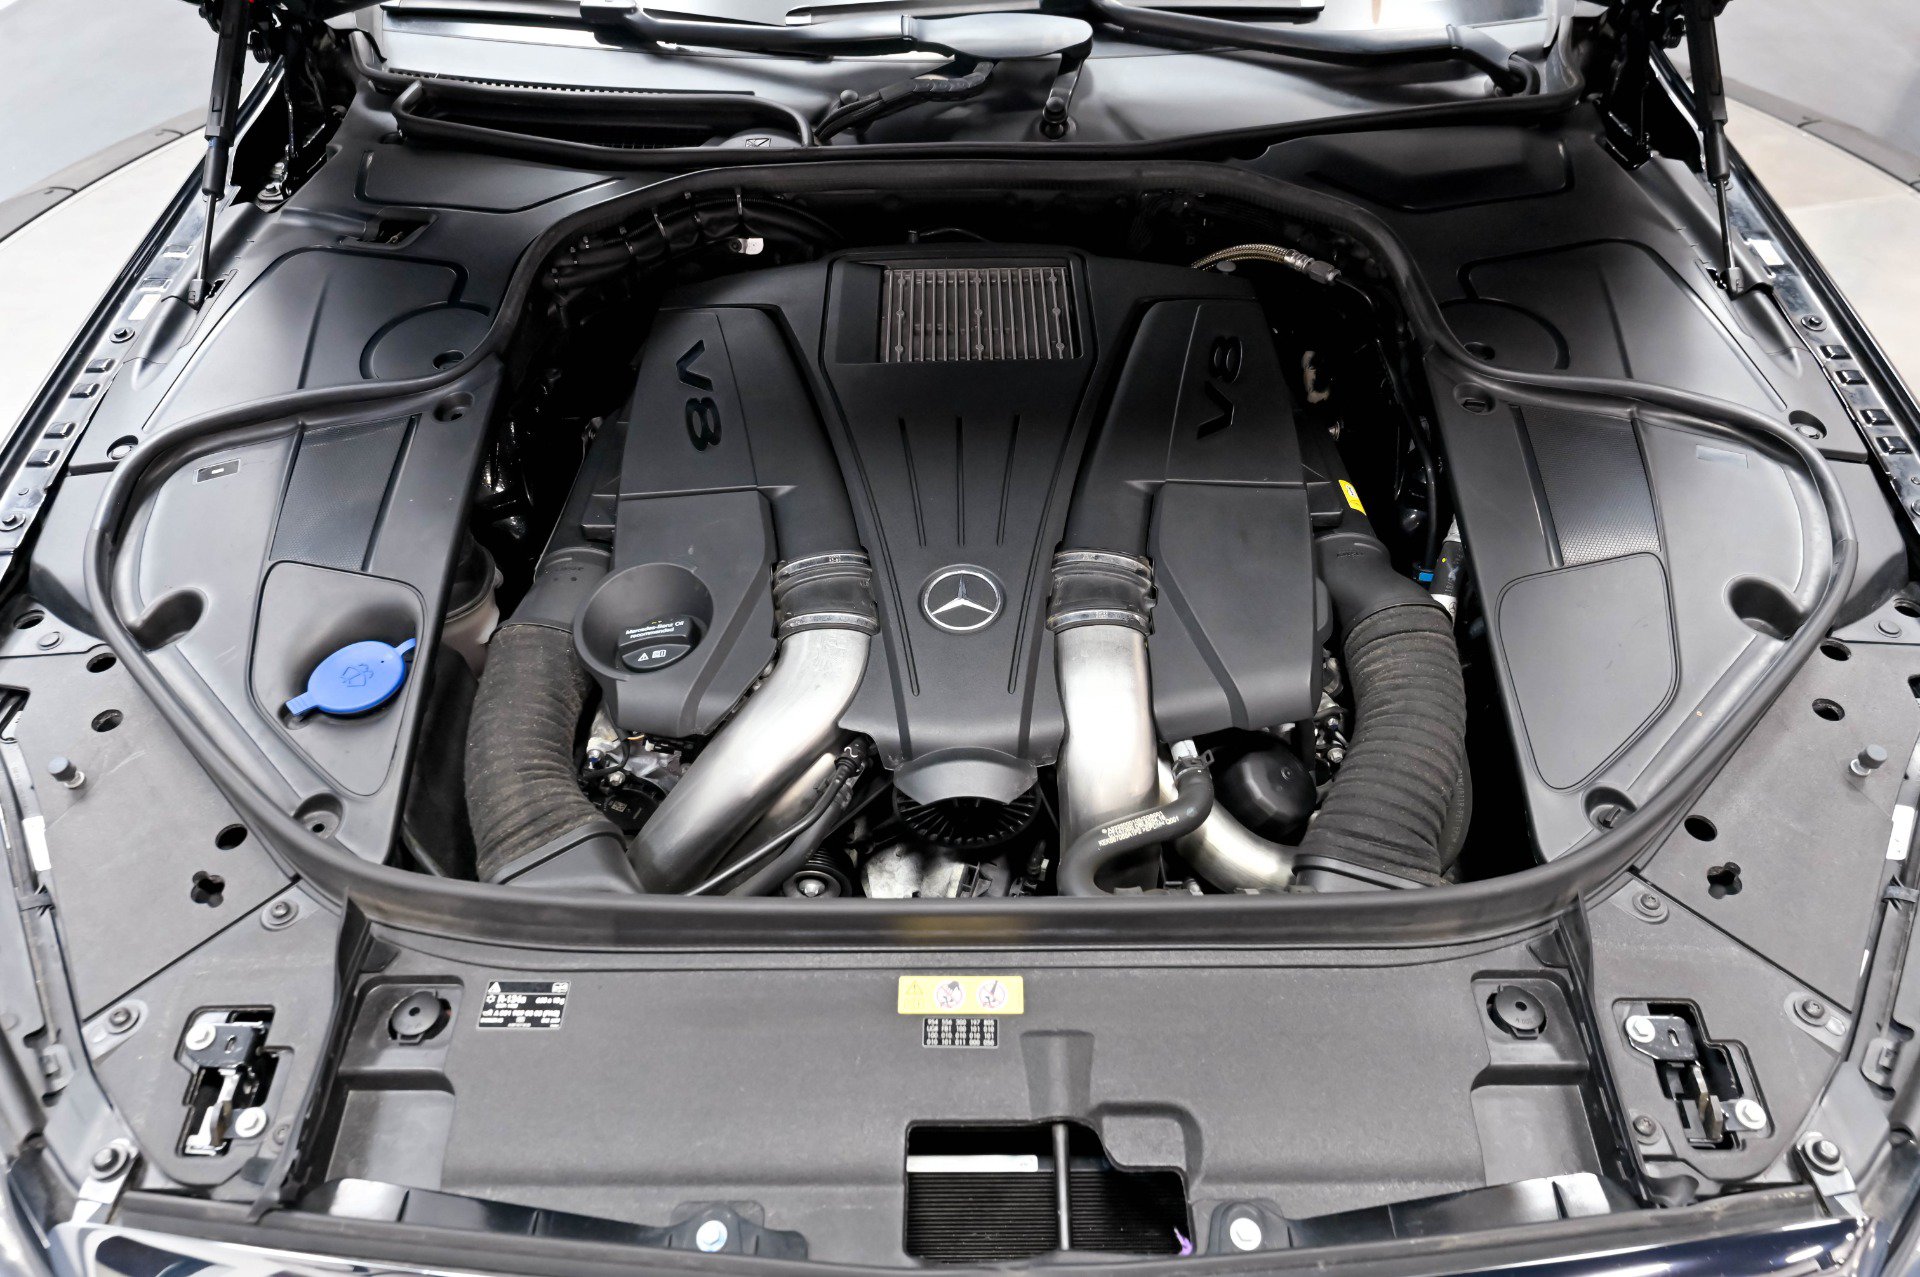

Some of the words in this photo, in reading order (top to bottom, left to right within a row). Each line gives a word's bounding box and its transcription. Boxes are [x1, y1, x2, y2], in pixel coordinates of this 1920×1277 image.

[676, 339, 722, 451] V8
[1196, 335, 1243, 440] V8
[625, 623, 674, 635] Mercedes-Benz
[630, 627, 675, 639] recommended
